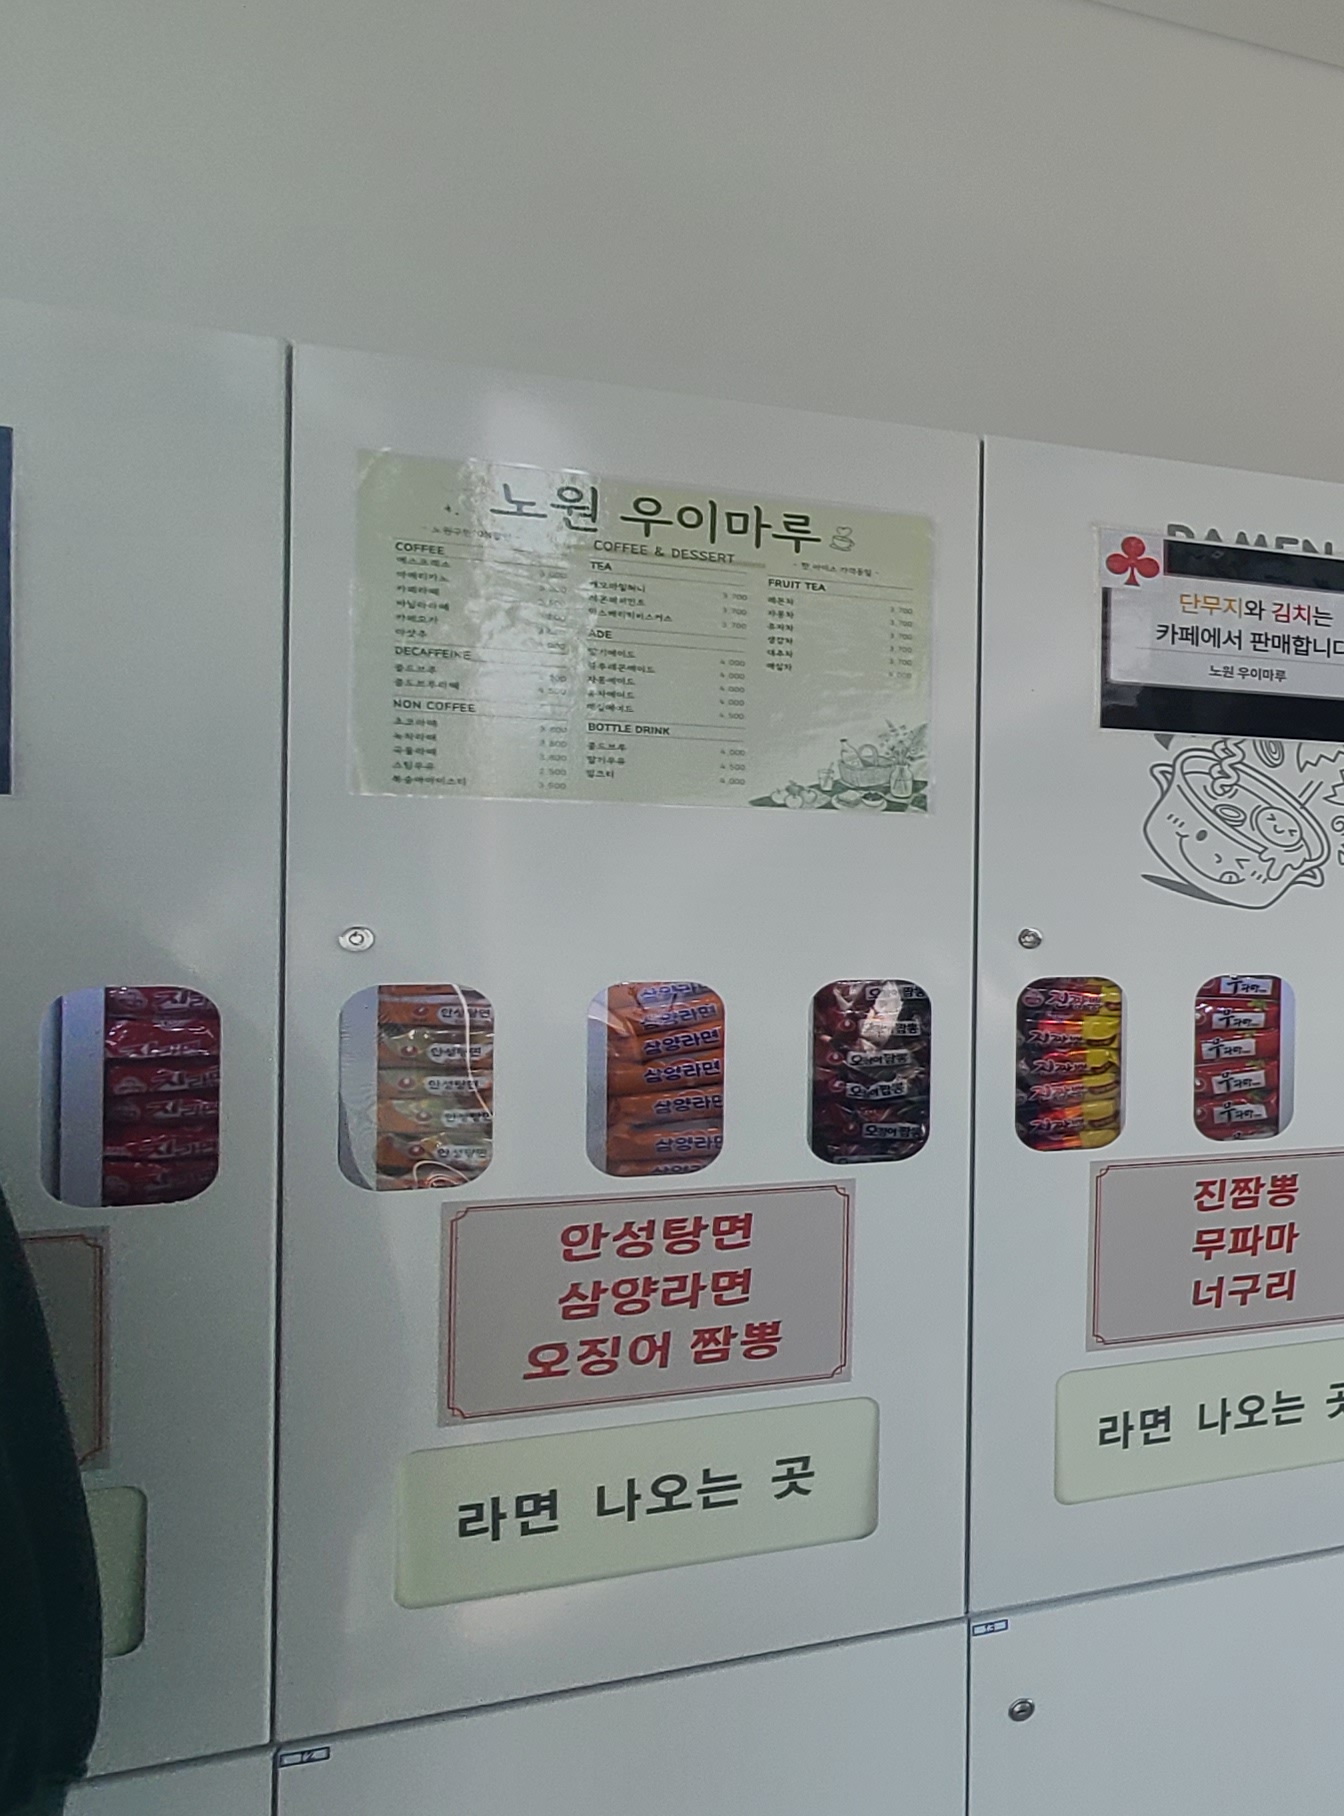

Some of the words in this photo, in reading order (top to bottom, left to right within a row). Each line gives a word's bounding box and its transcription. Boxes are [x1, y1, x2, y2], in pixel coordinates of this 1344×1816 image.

[490, 482, 599, 533] 노원
[620, 496, 822, 554] 우이마루
[395, 541, 445, 555] COFFEE
[594, 540, 648, 556] COFFEE
[655, 546, 664, 557] &
[671, 547, 735, 564] DESSERT
[590, 561, 612, 571] TEA
[768, 578, 801, 589] FRUIT
[805, 582, 826, 592] TEA
[1179, 593, 1265, 622] 단무지와
[1271, 602, 1334, 628] 김치는
[588, 629, 612, 639] ADE
[1155, 623, 1243, 650] 카페에서
[394, 646, 471, 660] DECAFFEINE
[1208, 664, 1234, 680] 노원
[1237, 666, 1287, 682] 우이마루
[393, 699, 422, 710] NON
[426, 700, 476, 713] COFFEE
[588, 722, 631, 733] BOTTLE
[635, 725, 670, 735] DRINK
[643, 1029, 719, 1056] 삼양라면
[644, 1060, 720, 1083] 삼양라면
[1193, 1173, 1299, 1212] 진짬뽕
[560, 1212, 754, 1263] 안성탕면
[1191, 1222, 1299, 1261] 무파마
[557, 1267, 753, 1321] 삼양라면
[1191, 1270, 1297, 1309] 너구리
[521, 1331, 672, 1381] 오징어
[690, 1319, 783, 1365] 짬뽕
[1098, 1405, 1172, 1450] 라면
[1198, 1390, 1305, 1436] 나오는
[457, 1489, 559, 1542] 라면
[596, 1468, 743, 1523] 나오는
[772, 1455, 815, 1501] 곳
